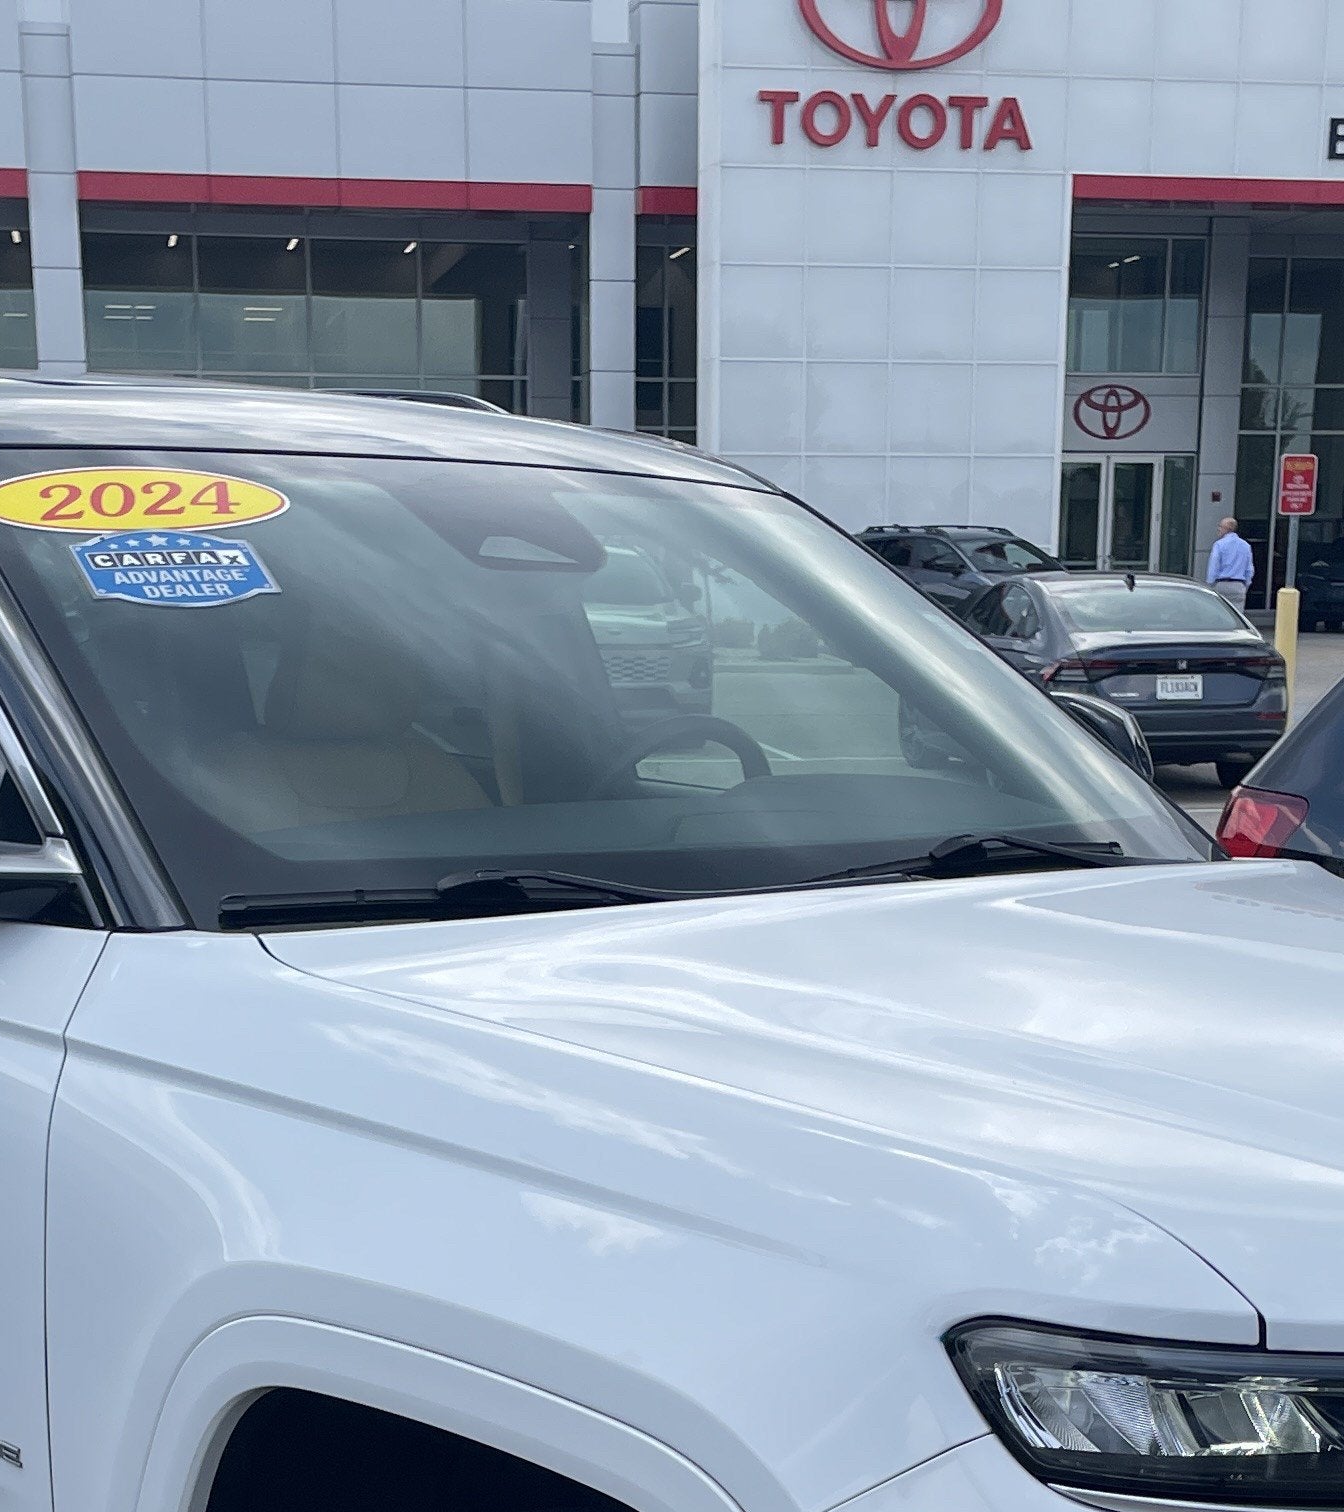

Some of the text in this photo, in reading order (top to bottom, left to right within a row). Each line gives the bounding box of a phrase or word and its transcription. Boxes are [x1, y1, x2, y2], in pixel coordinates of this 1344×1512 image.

[758, 90, 1032, 151] TOYOTA
[38, 480, 240, 522] 2024
[90, 550, 250, 570] CARFAX
[114, 568, 247, 586] ADVANTAGE
[143, 582, 235, 599] DEALER
